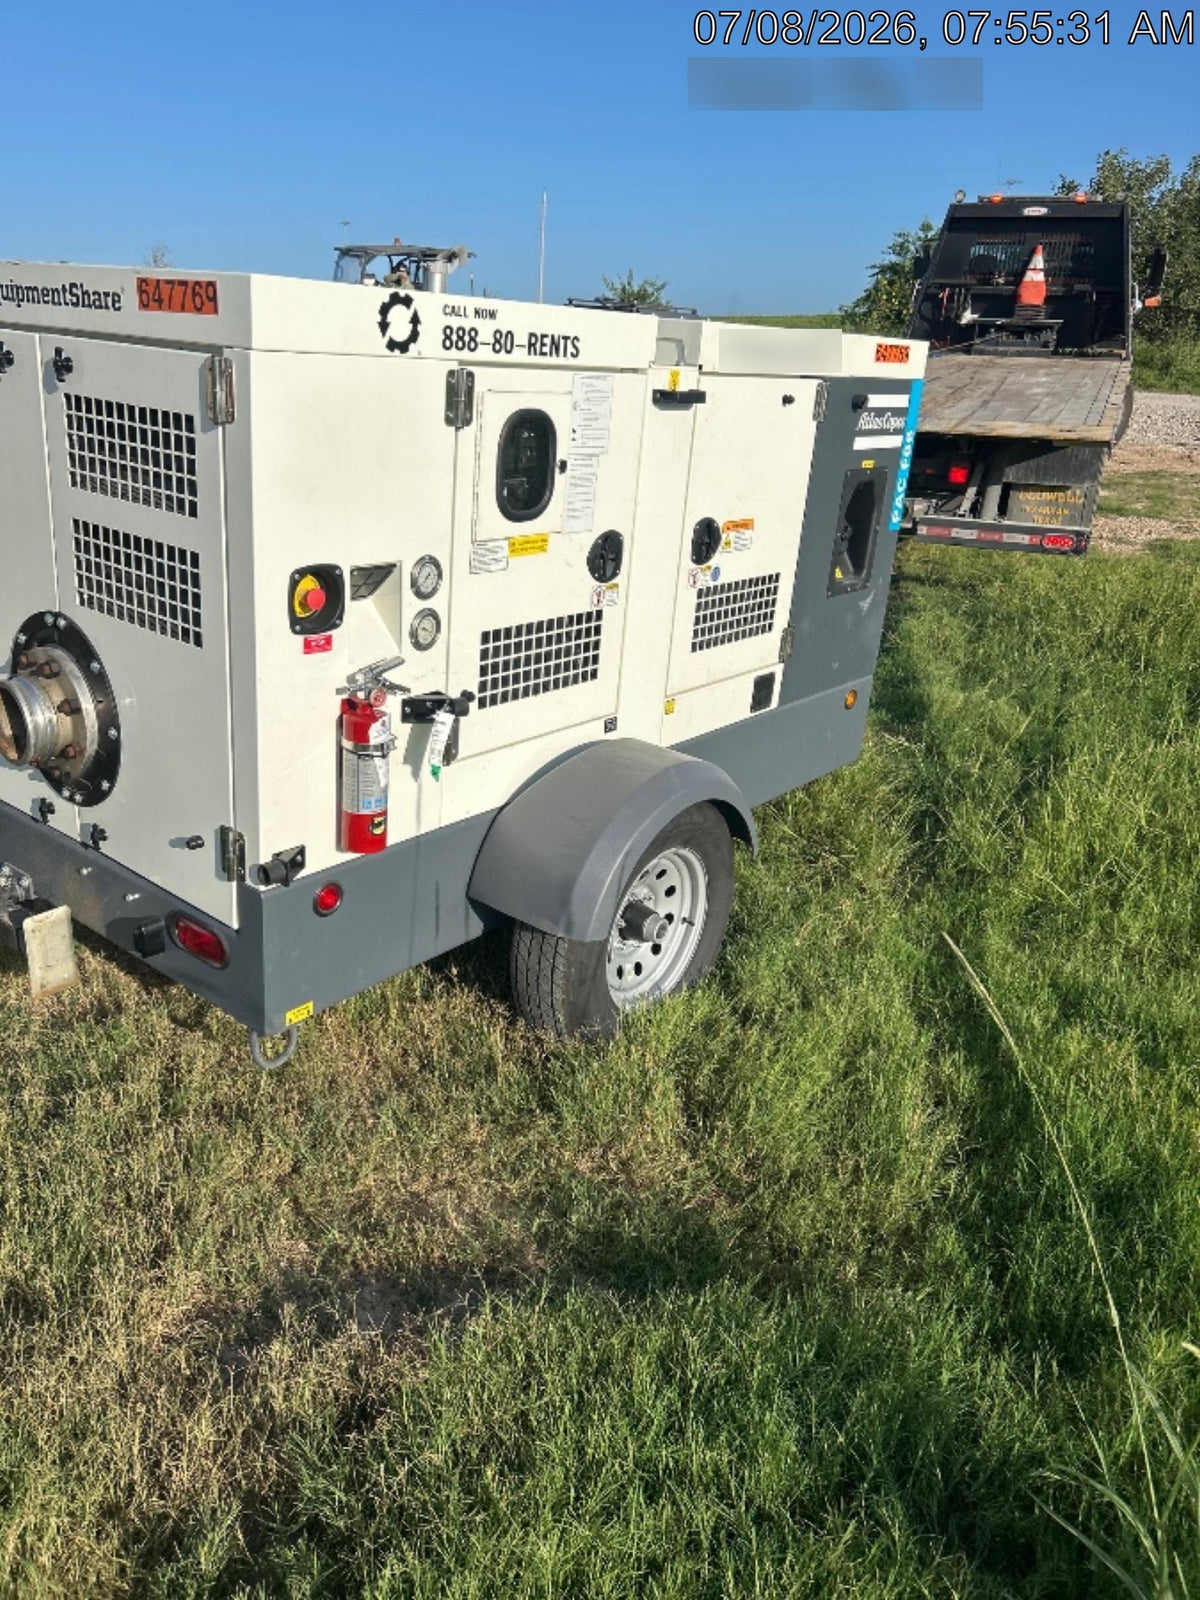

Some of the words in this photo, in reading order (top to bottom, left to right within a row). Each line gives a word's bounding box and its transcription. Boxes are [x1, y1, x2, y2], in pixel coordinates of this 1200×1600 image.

[0, 279, 122, 312] uipmentShare
[138, 279, 219, 315] 647769
[442, 304, 469, 318] CALL
[474, 307, 498, 320] NOW
[442, 325, 580, 358] 888-80-RENTS
